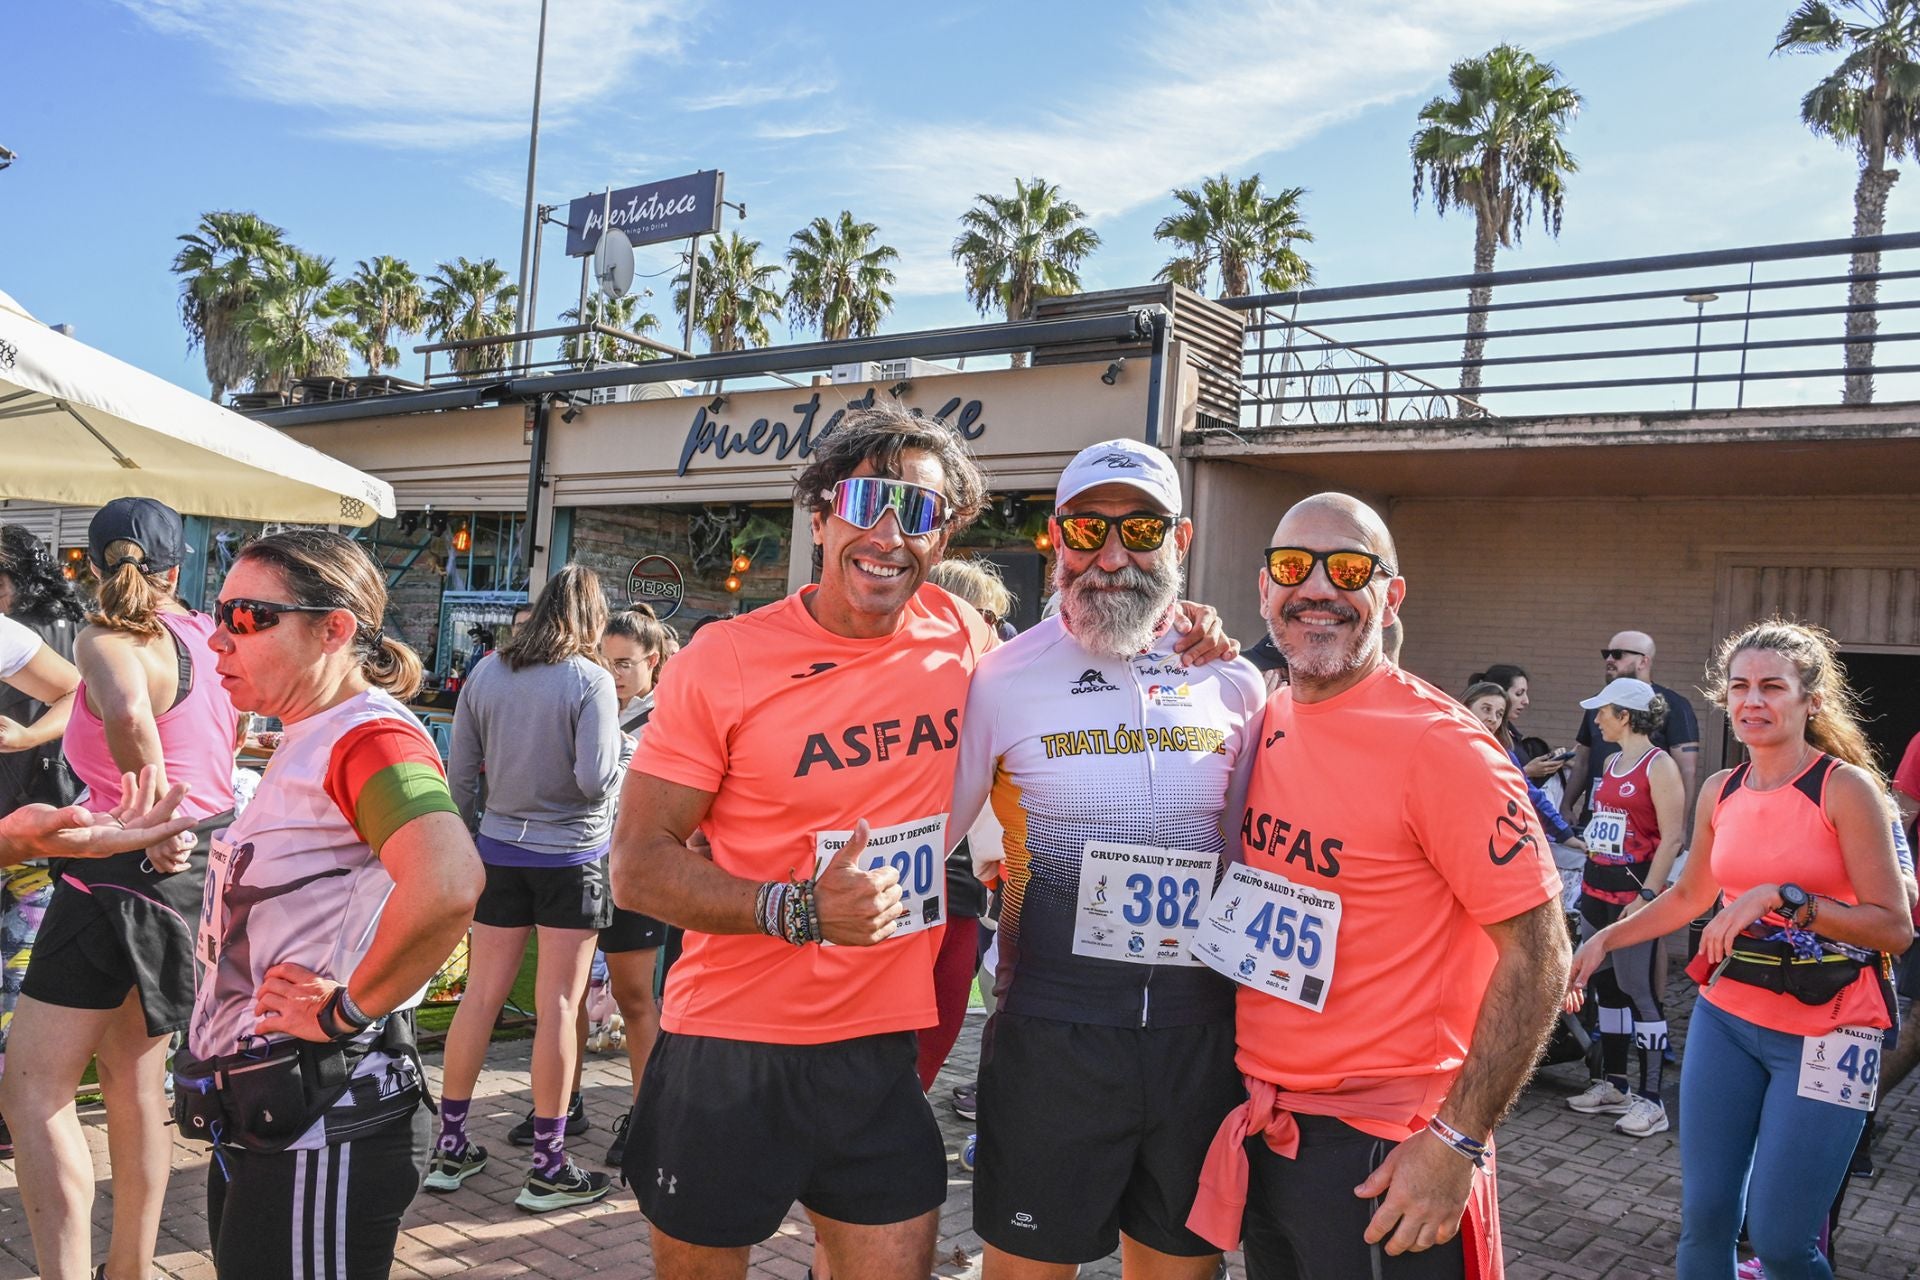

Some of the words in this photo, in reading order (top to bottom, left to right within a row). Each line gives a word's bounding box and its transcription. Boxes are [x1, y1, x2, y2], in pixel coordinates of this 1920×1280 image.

[582, 192, 696, 240] puertatrece
[631, 578, 681, 599] PEPSI
[793, 708, 958, 778] ASFAS
[1041, 723, 1145, 758] TRIATLÓN
[1145, 726, 1227, 755] PACENSE
[866, 834, 898, 847] SALUD
[899, 832, 906, 841] Y
[907, 822, 941, 839] DEPORTE
[1240, 807, 1343, 878] ASFAS
[1590, 821, 1620, 842] 380
[1090, 850, 1130, 862] GRUPO
[1132, 854, 1164, 865] SALUD
[1166, 858, 1174, 866] Y
[1175, 858, 1212, 870] DEPORTE
[1233, 872, 1263, 887] GRUPO
[1263, 881, 1290, 896] SALUD
[1290, 888, 1296, 898] Y
[1122, 873, 1200, 929] 382
[1244, 901, 1324, 969] 455
[1844, 1029, 1873, 1041] SALUD
[1837, 1043, 1881, 1085] 48
[1010, 1219, 1038, 1231] Kalenji
